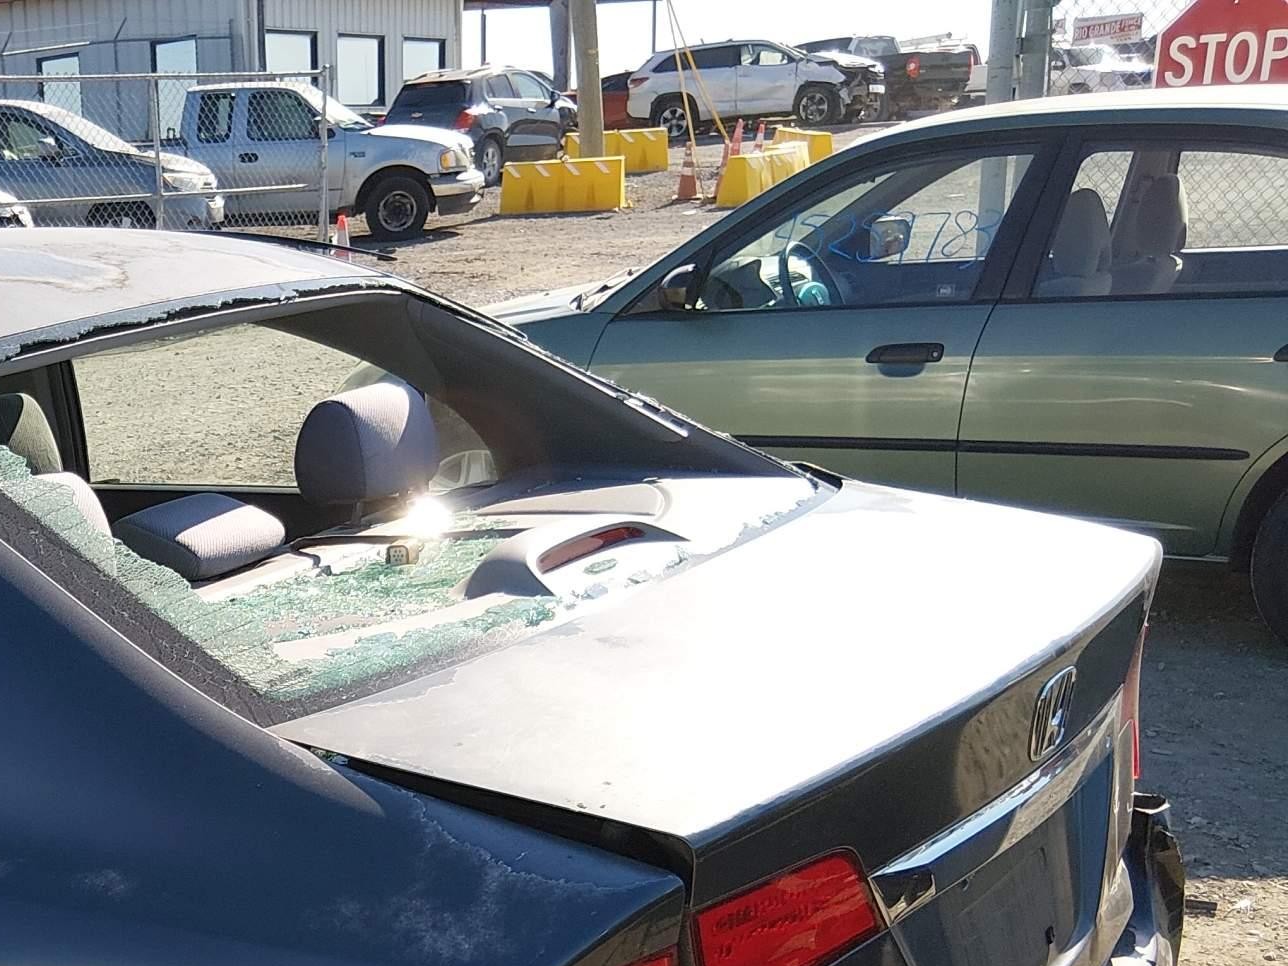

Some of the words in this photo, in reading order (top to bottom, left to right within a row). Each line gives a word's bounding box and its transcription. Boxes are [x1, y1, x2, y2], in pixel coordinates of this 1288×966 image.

[1074, 27, 1087, 40] RIO
[1088, 22, 1120, 38] GRANDE
[1164, 28, 1288, 87] STOP
